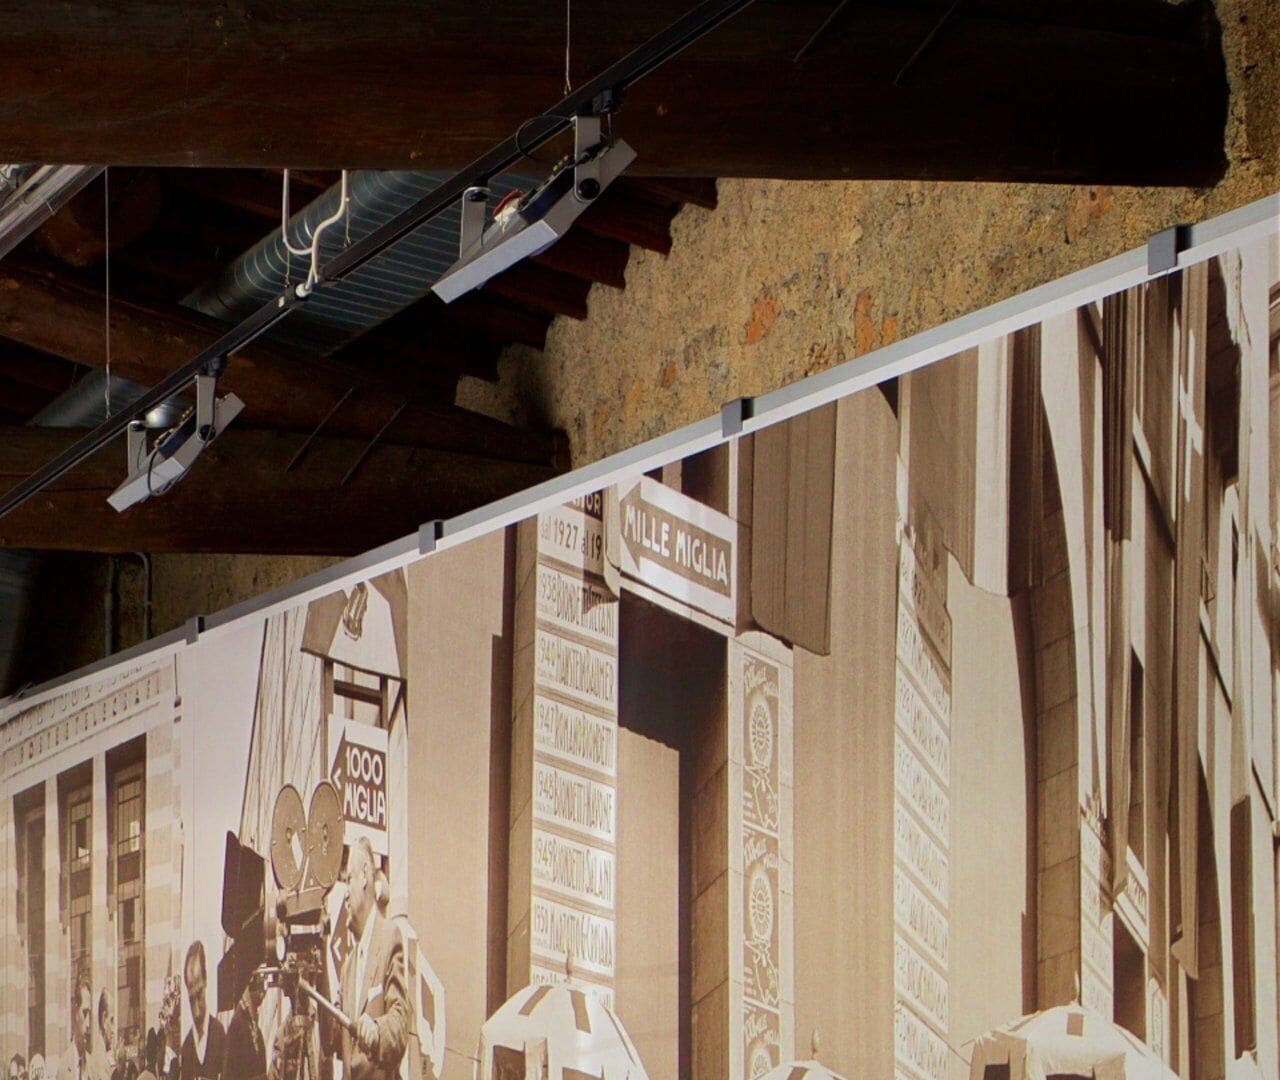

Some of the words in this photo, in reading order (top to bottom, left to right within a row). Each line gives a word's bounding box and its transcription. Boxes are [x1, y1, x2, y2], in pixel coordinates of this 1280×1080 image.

[553, 517, 579, 552] 1927
[591, 531, 602, 562] 19
[624, 504, 671, 558] MILLE
[675, 529, 728, 587] MIGLIA
[346, 745, 383, 785] 1000
[343, 782, 386, 826] MIGLIA
